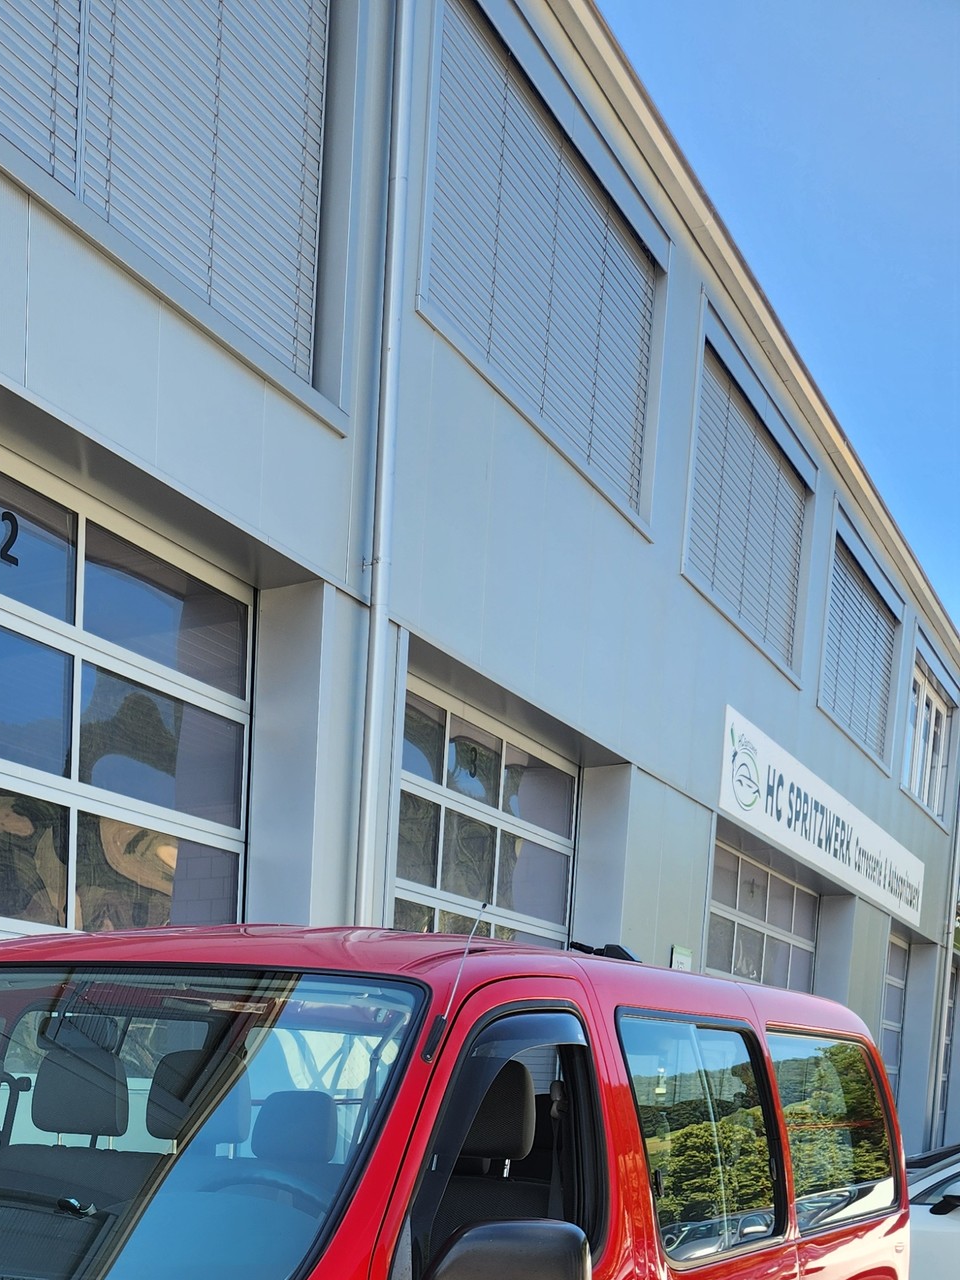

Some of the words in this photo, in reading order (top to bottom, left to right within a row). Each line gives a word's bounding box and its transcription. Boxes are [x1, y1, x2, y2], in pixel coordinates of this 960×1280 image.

[0, 511, 19, 567] 2
[469, 747, 477, 778] 3
[765, 764, 784, 822] HC
[786, 782, 853, 867] SPRITZWERK
